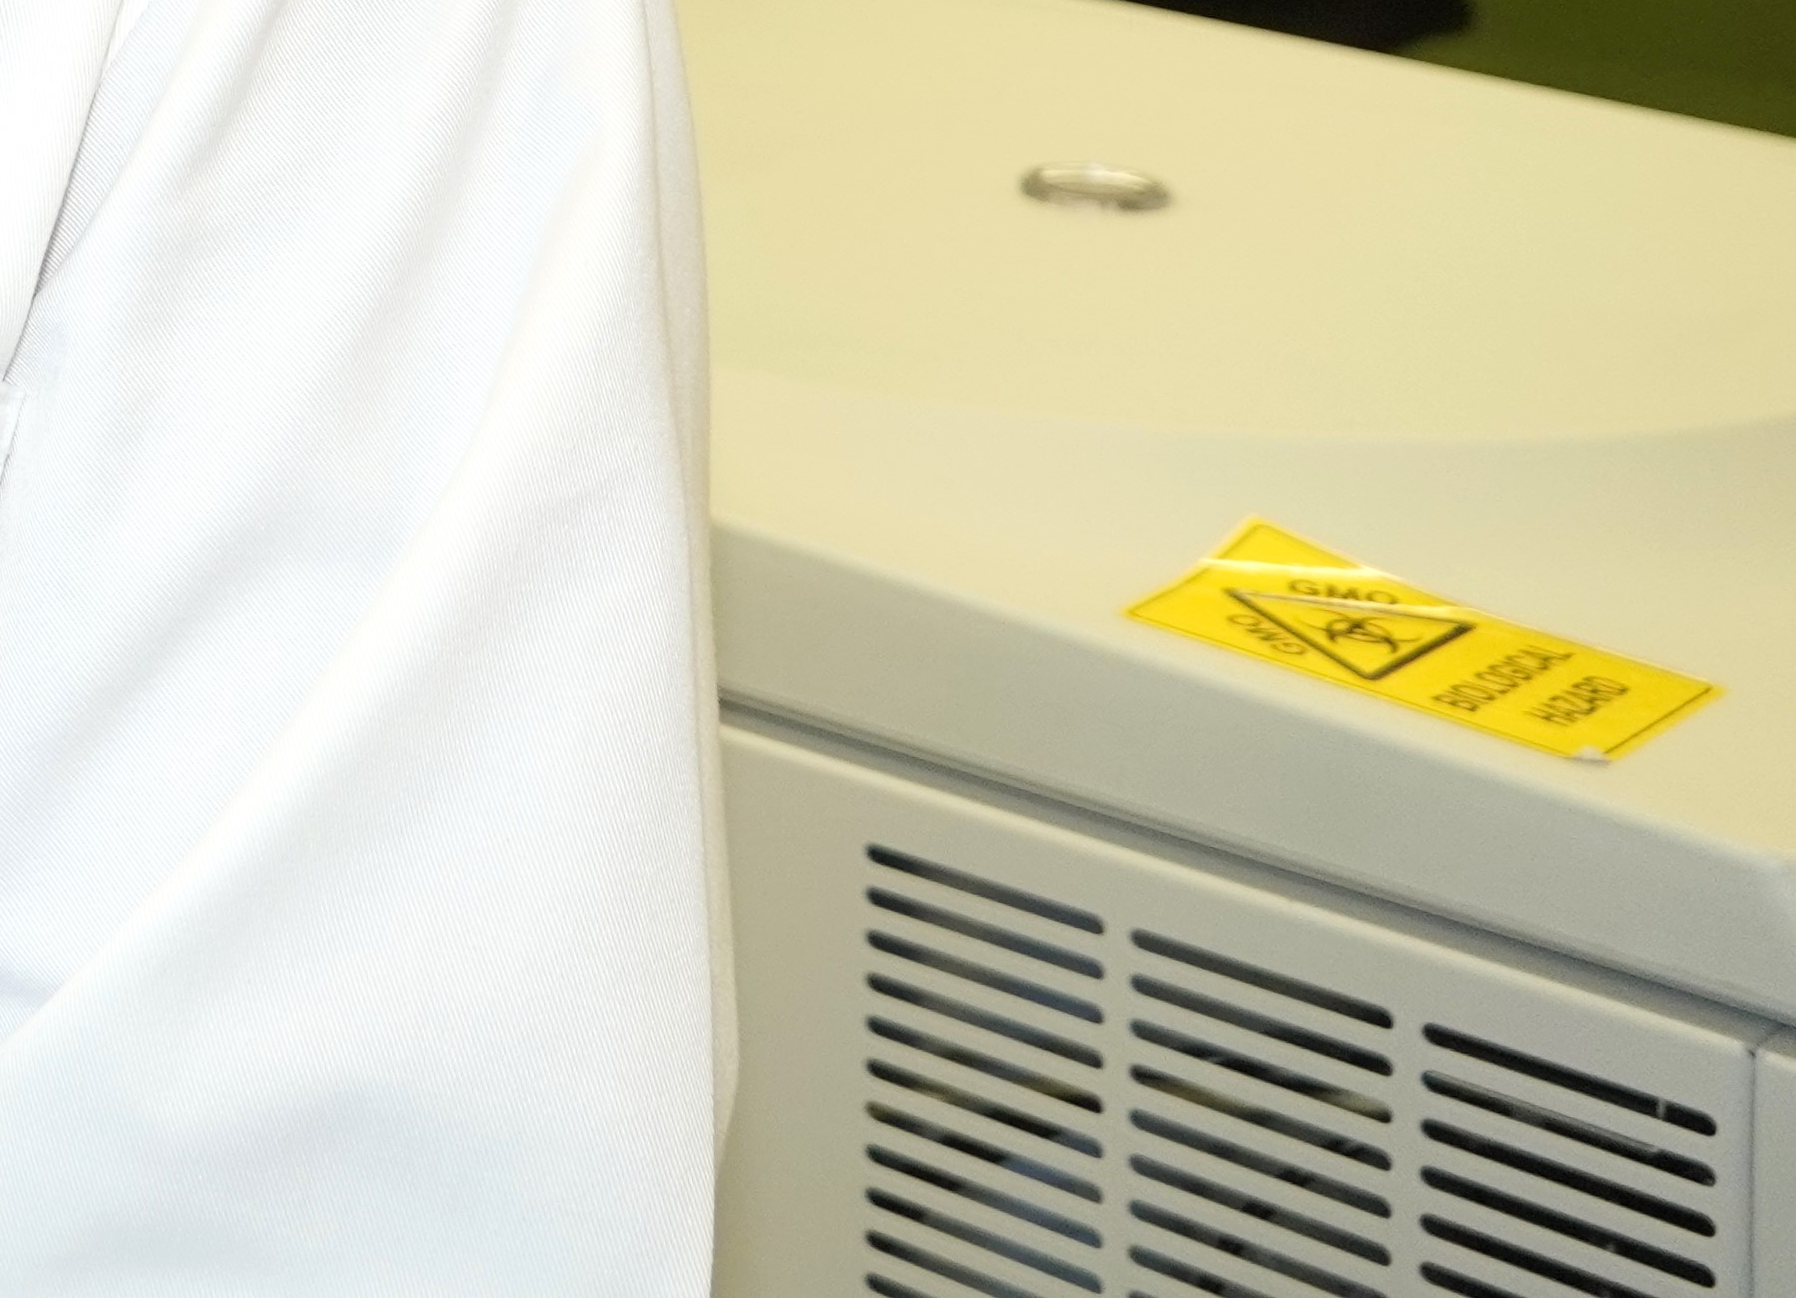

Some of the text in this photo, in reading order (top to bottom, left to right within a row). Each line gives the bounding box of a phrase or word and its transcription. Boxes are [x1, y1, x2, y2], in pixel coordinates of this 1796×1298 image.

[1288, 578, 1399, 604] GMO
[1431, 643, 1575, 713] BIOLOGICAL
[1521, 675, 1630, 726] HAZARD
